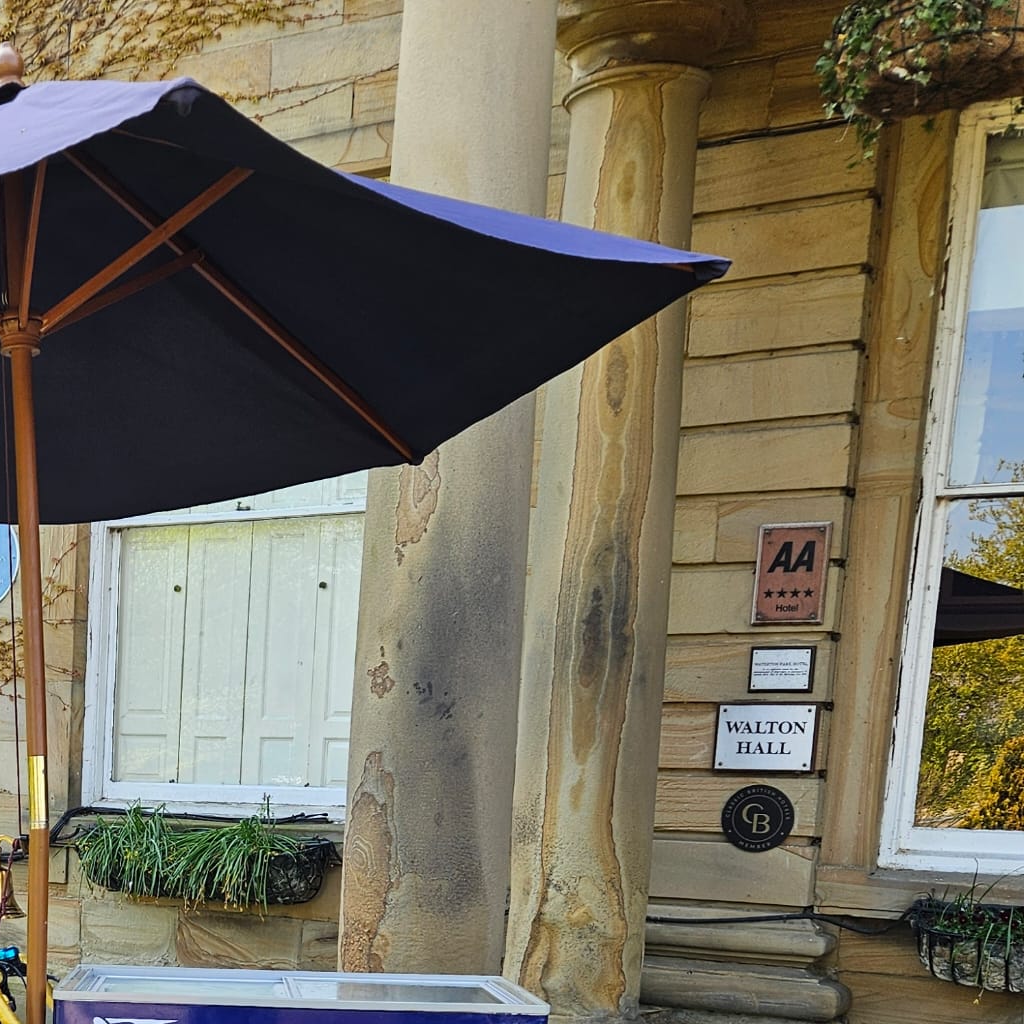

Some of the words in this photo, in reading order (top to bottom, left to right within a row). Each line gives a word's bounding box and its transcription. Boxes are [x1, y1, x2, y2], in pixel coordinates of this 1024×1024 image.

[767, 540, 816, 573] AA
[776, 604, 799, 612] Hotel
[726, 721, 808, 735] WALTON
[736, 741, 791, 755] HALL
